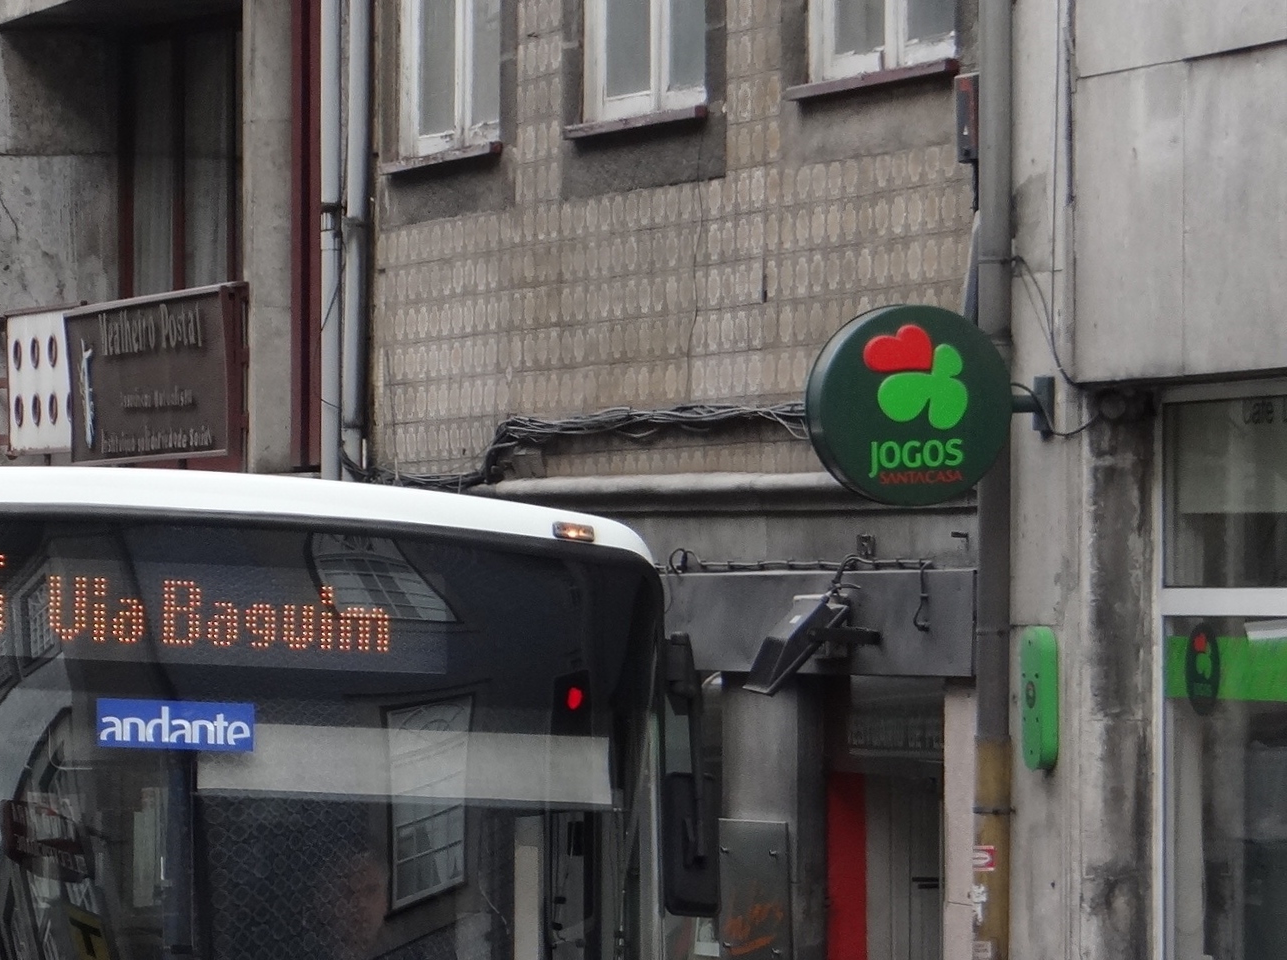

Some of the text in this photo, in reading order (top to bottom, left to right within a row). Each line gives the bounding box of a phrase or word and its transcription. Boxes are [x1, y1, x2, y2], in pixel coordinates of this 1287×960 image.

[159, 301, 202, 349] Postal
[868, 438, 963, 478] JOGOS
[163, 580, 390, 651] Baguim
[100, 706, 251, 745] andante
